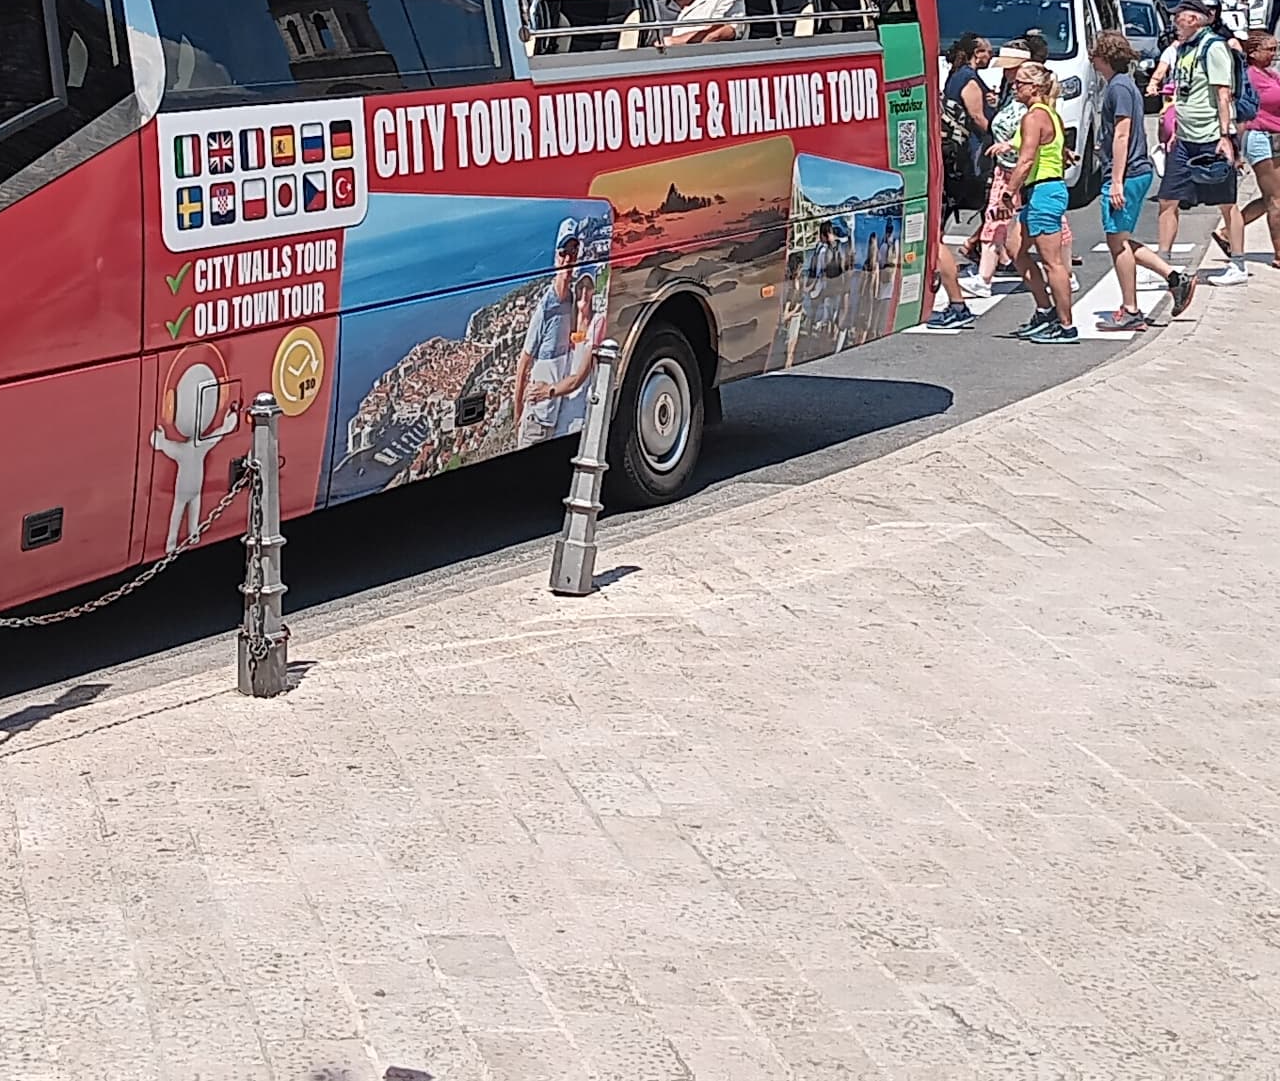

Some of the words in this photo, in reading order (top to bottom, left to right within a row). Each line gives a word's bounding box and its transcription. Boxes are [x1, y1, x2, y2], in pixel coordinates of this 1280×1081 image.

[373, 104, 446, 178] CITY
[452, 97, 533, 169] TOUR
[538, 88, 623, 159] AUDIO
[627, 82, 702, 148] GUIDE
[707, 81, 726, 138] &
[728, 72, 826, 136] WALKING
[827, 68, 879, 124] TOUR
[194, 254, 235, 293] CITY
[237, 245, 292, 285] WALLS
[295, 238, 337, 275] TOUR
[194, 299, 229, 337] OLD
[232, 289, 279, 330] TOWN
[282, 281, 325, 319] TOUR
